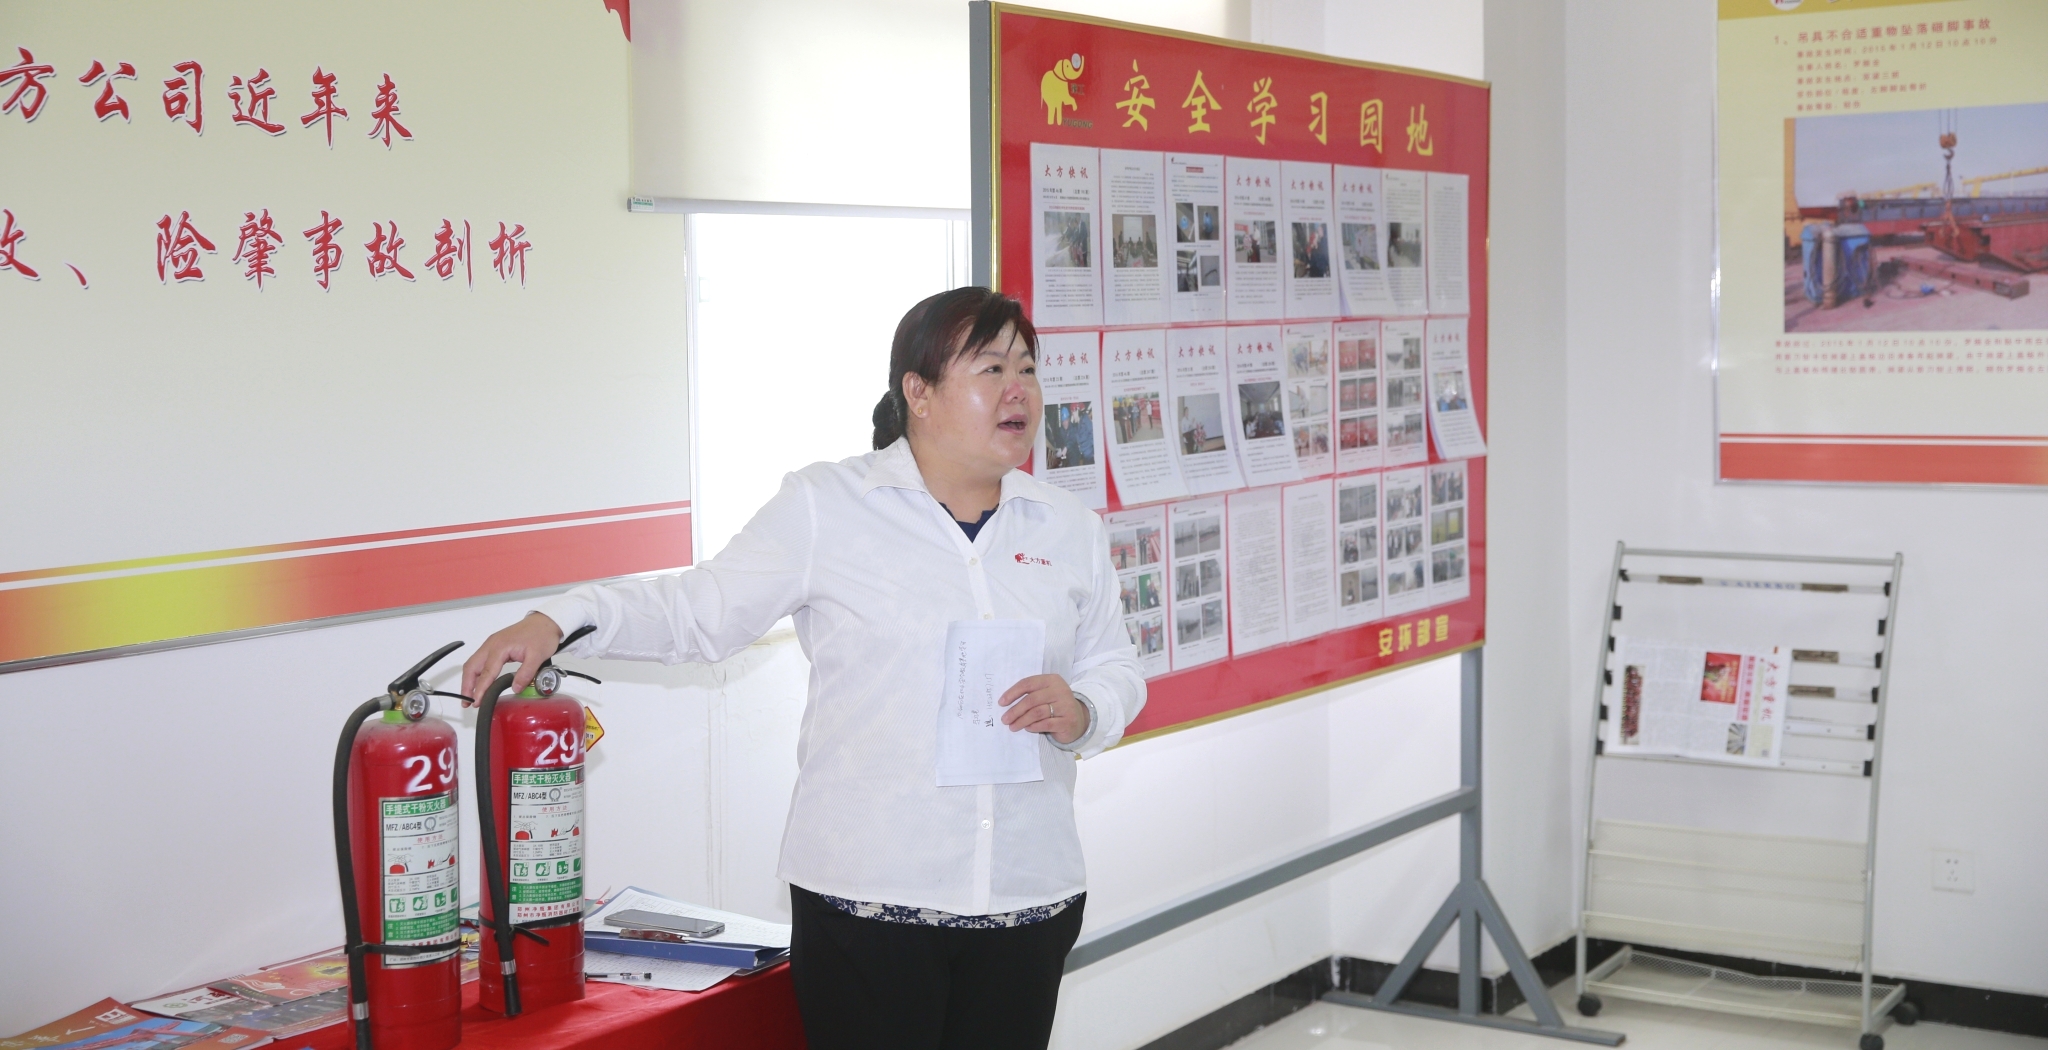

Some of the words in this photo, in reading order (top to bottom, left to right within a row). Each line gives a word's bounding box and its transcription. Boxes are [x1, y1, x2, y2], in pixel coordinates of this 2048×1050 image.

[0, 47, 413, 147] 方公司近年来
[1115, 59, 1434, 157] 安全学习园地
[1061, 118, 1093, 129] YUGONG
[403, 746, 458, 794] 29
[514, 772, 571, 785] 手提式干粉灭火器
[386, 801, 446, 815] 手提式干粉灭火器
[541, 805, 568, 813] 使用方法
